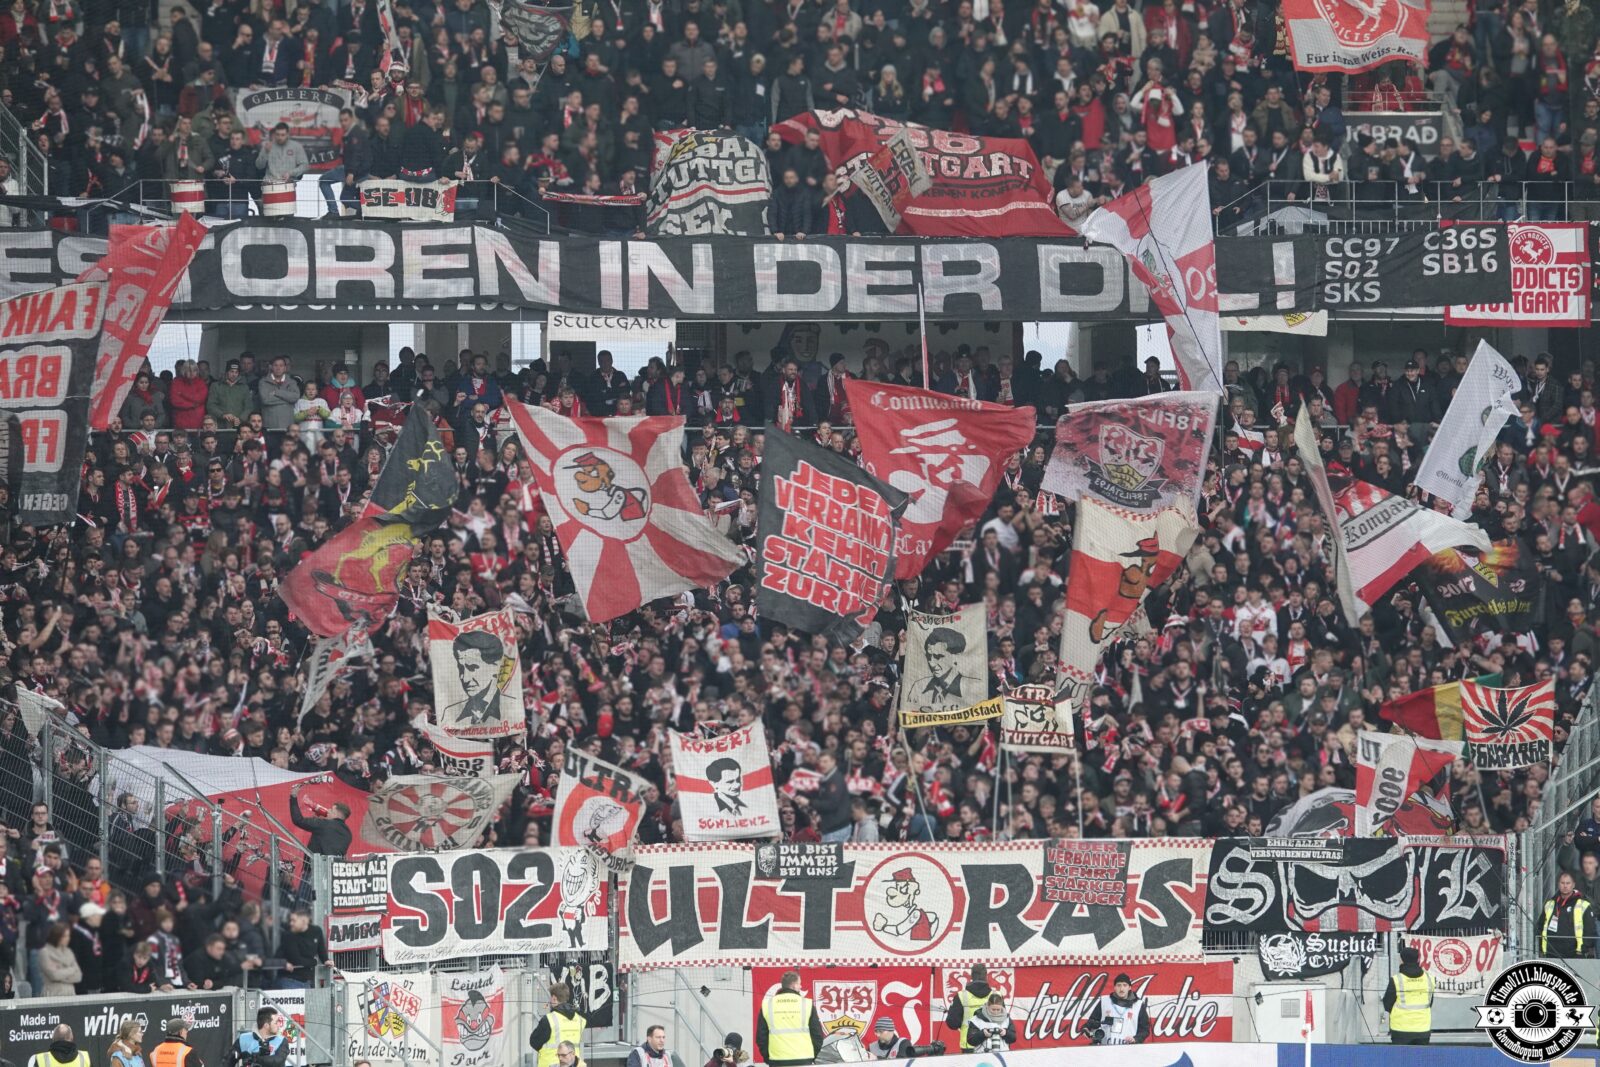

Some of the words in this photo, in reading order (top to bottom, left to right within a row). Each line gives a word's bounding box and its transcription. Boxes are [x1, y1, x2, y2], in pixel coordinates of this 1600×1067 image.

[1306, 53, 1329, 64] Für
[251, 91, 333, 105] GALEERE
[1325, 236, 1400, 258] CC97
[1423, 227, 1498, 251] C36S
[1422, 250, 1499, 276] SB16
[599, 235, 714, 313] IN
[754, 240, 1003, 313] DER
[1512, 267, 1580, 290] DDICTS
[1323, 281, 1381, 303] SKS
[553, 314, 670, 331] STUTTGART
[680, 727, 753, 753] ROBERT
[779, 844, 799, 854] DU
[806, 843, 837, 854] BIST
[1295, 839, 1327, 847] ALLEN
[779, 855, 837, 867] IMMER
[1047, 847, 1126, 867] VERBANNTE
[1251, 849, 1312, 859] VERSTORBENEN
[332, 862, 366, 877] GEGEN
[779, 866, 801, 876] BEI
[806, 866, 839, 876] UNS!
[1053, 864, 1120, 879] KEHRT
[394, 946, 433, 961] Ultras
[1434, 975, 1486, 994] tuttgart
[1152, 975, 1219, 1038] die
[20, 1015, 46, 1027] Made
[48, 1013, 60, 1025] im
[9, 1029, 54, 1043] Schwarzw
